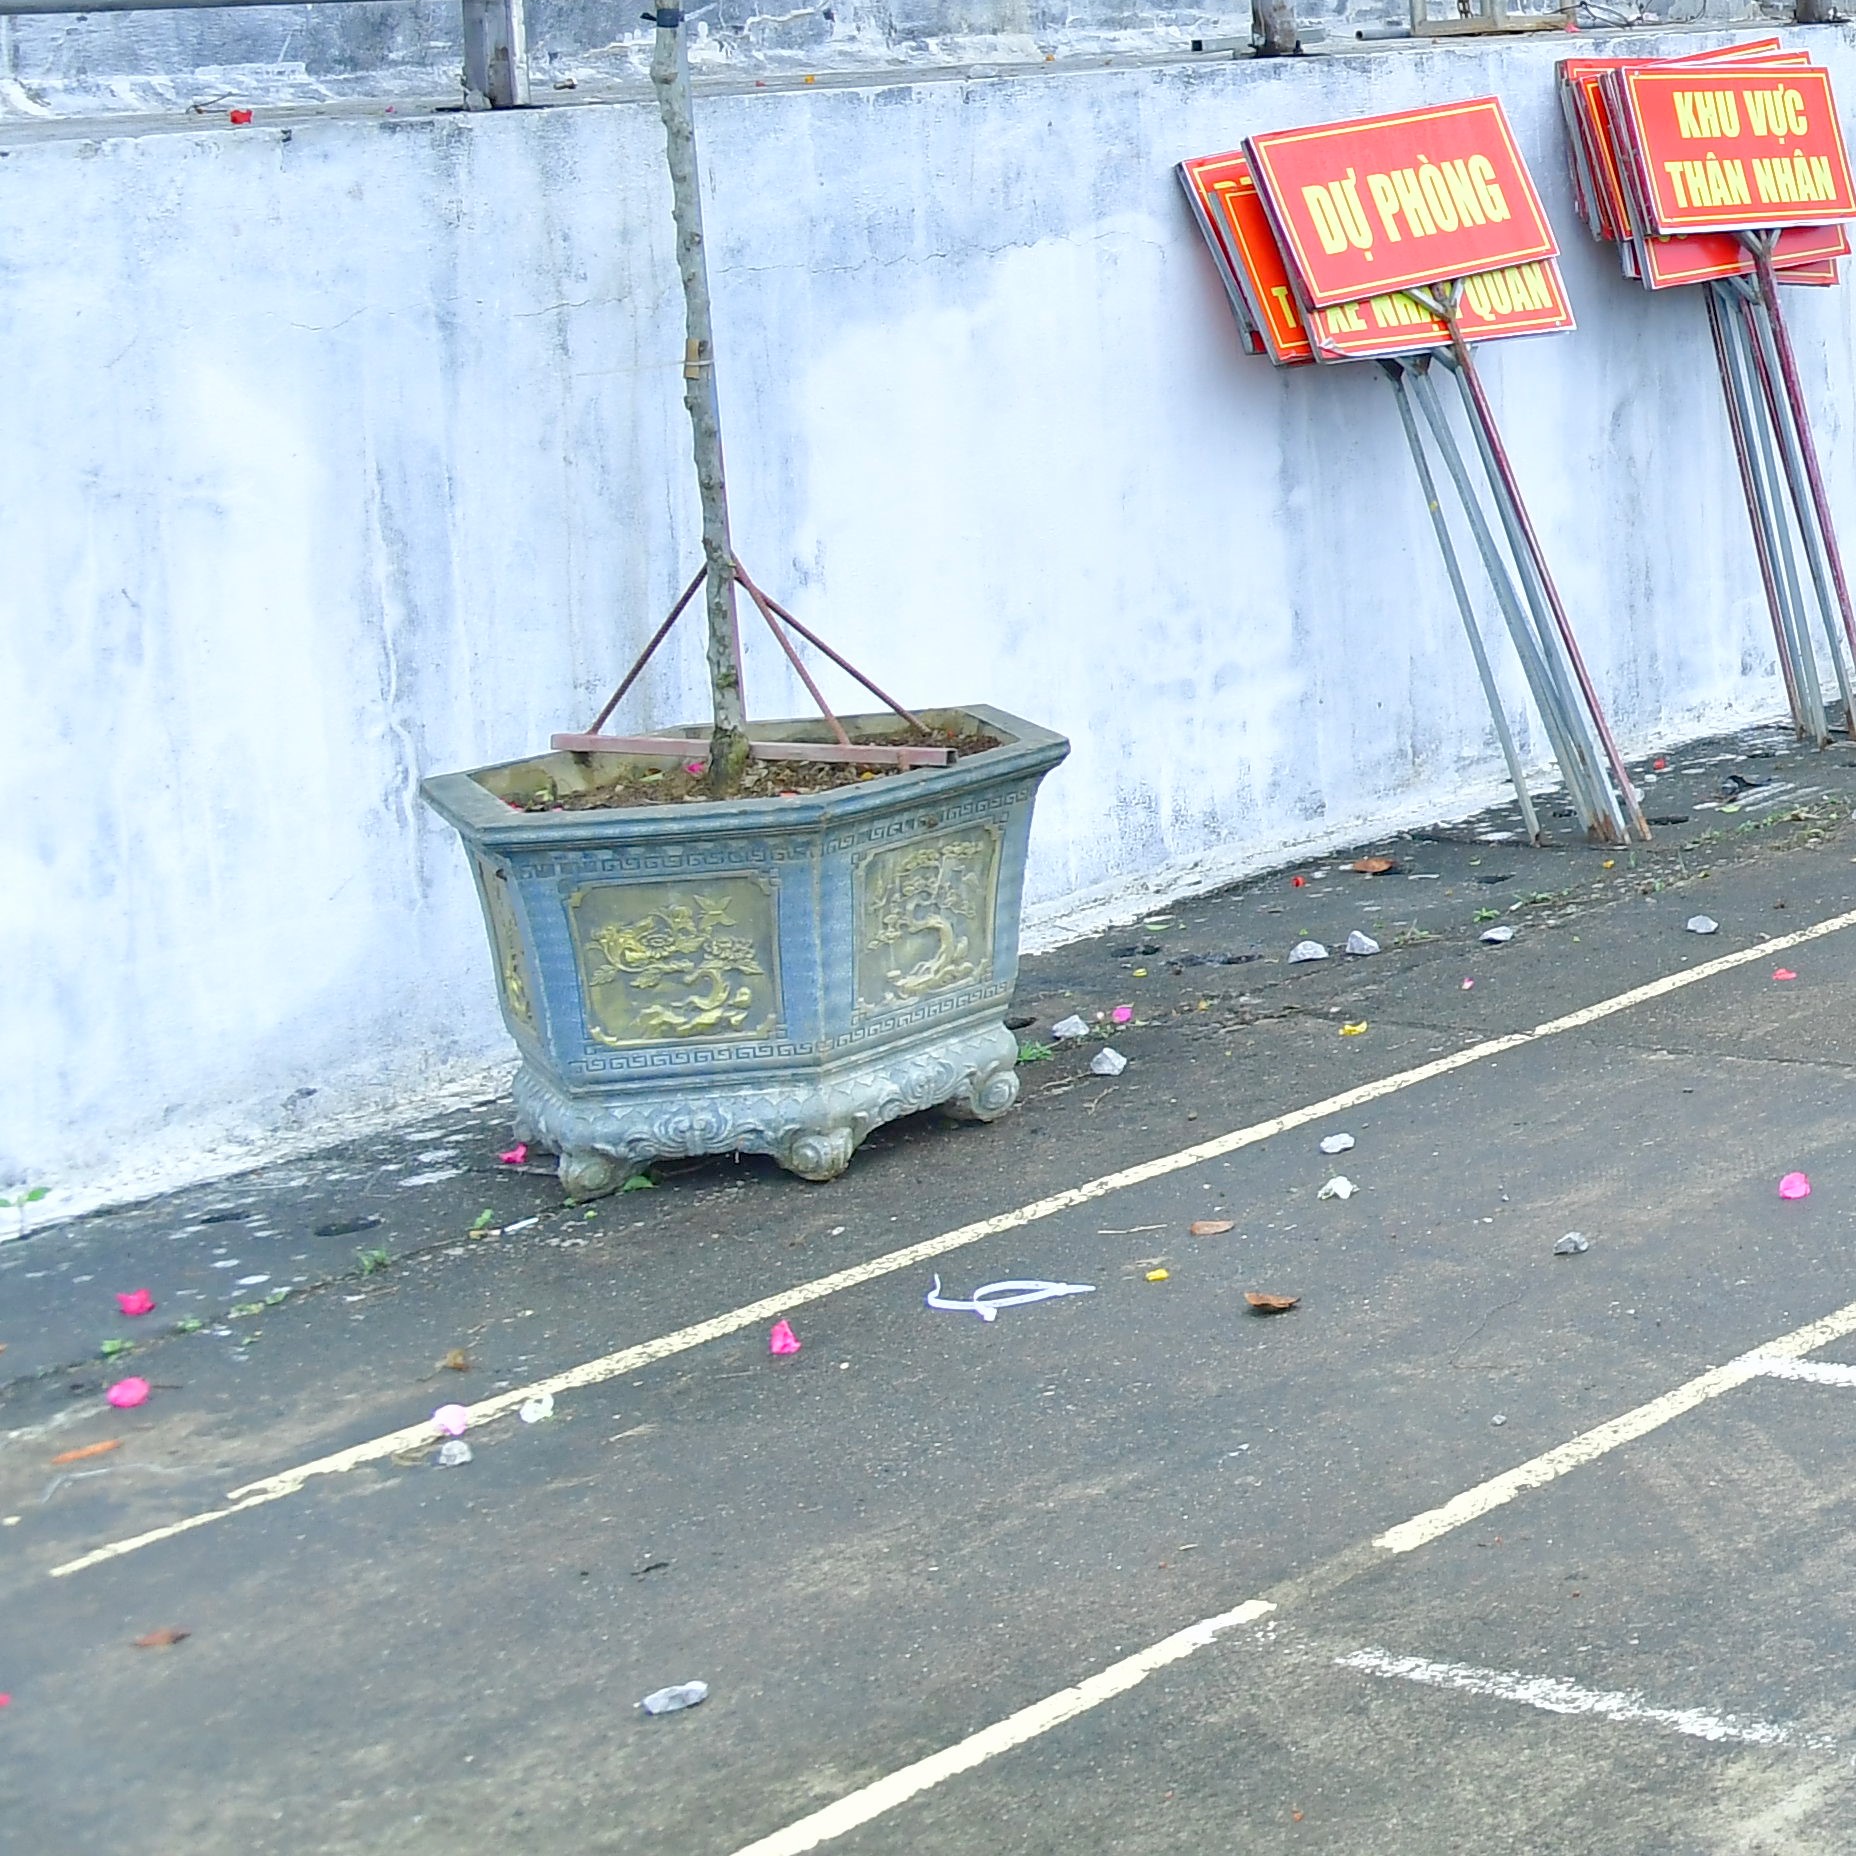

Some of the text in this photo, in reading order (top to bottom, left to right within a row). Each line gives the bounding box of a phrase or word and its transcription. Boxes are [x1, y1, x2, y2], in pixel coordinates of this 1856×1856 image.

[1672, 83, 1808, 145] KHU VỰC
[1301, 154, 1512, 262] DỰ PHÒNG
[1663, 148, 1837, 209] THÂN NHÂN
